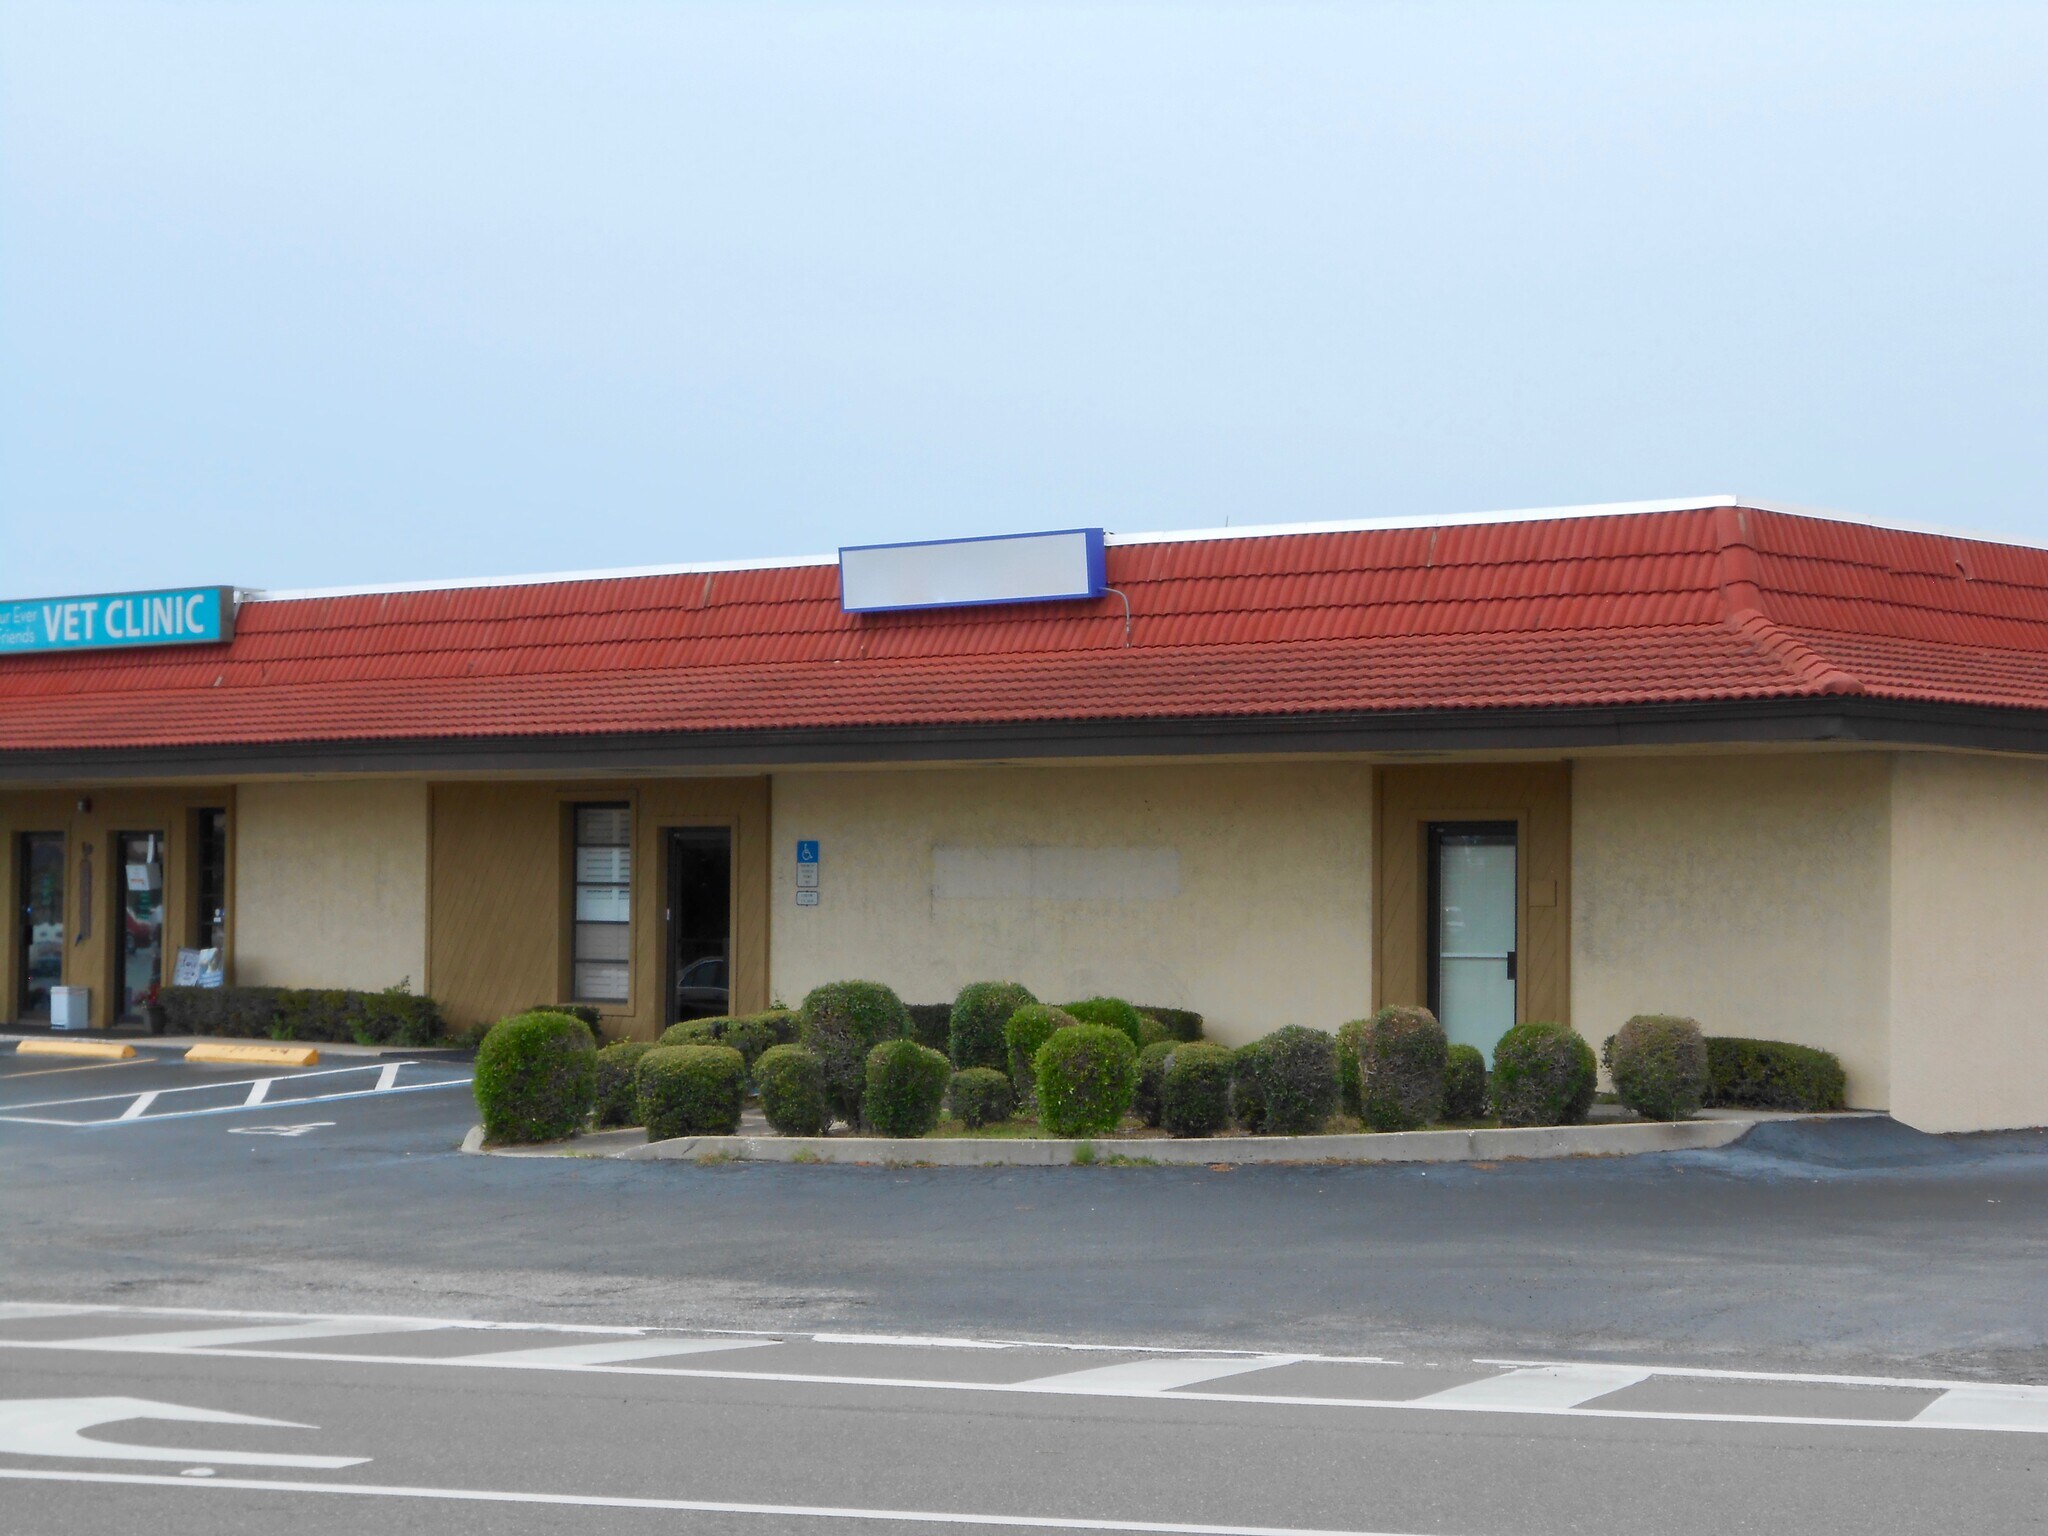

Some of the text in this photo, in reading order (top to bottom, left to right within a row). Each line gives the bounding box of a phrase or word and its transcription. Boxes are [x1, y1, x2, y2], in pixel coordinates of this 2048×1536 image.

[14, 606, 37, 623] Ever
[43, 594, 204, 641] VET CLINIC
[0, 626, 35, 644] riends
